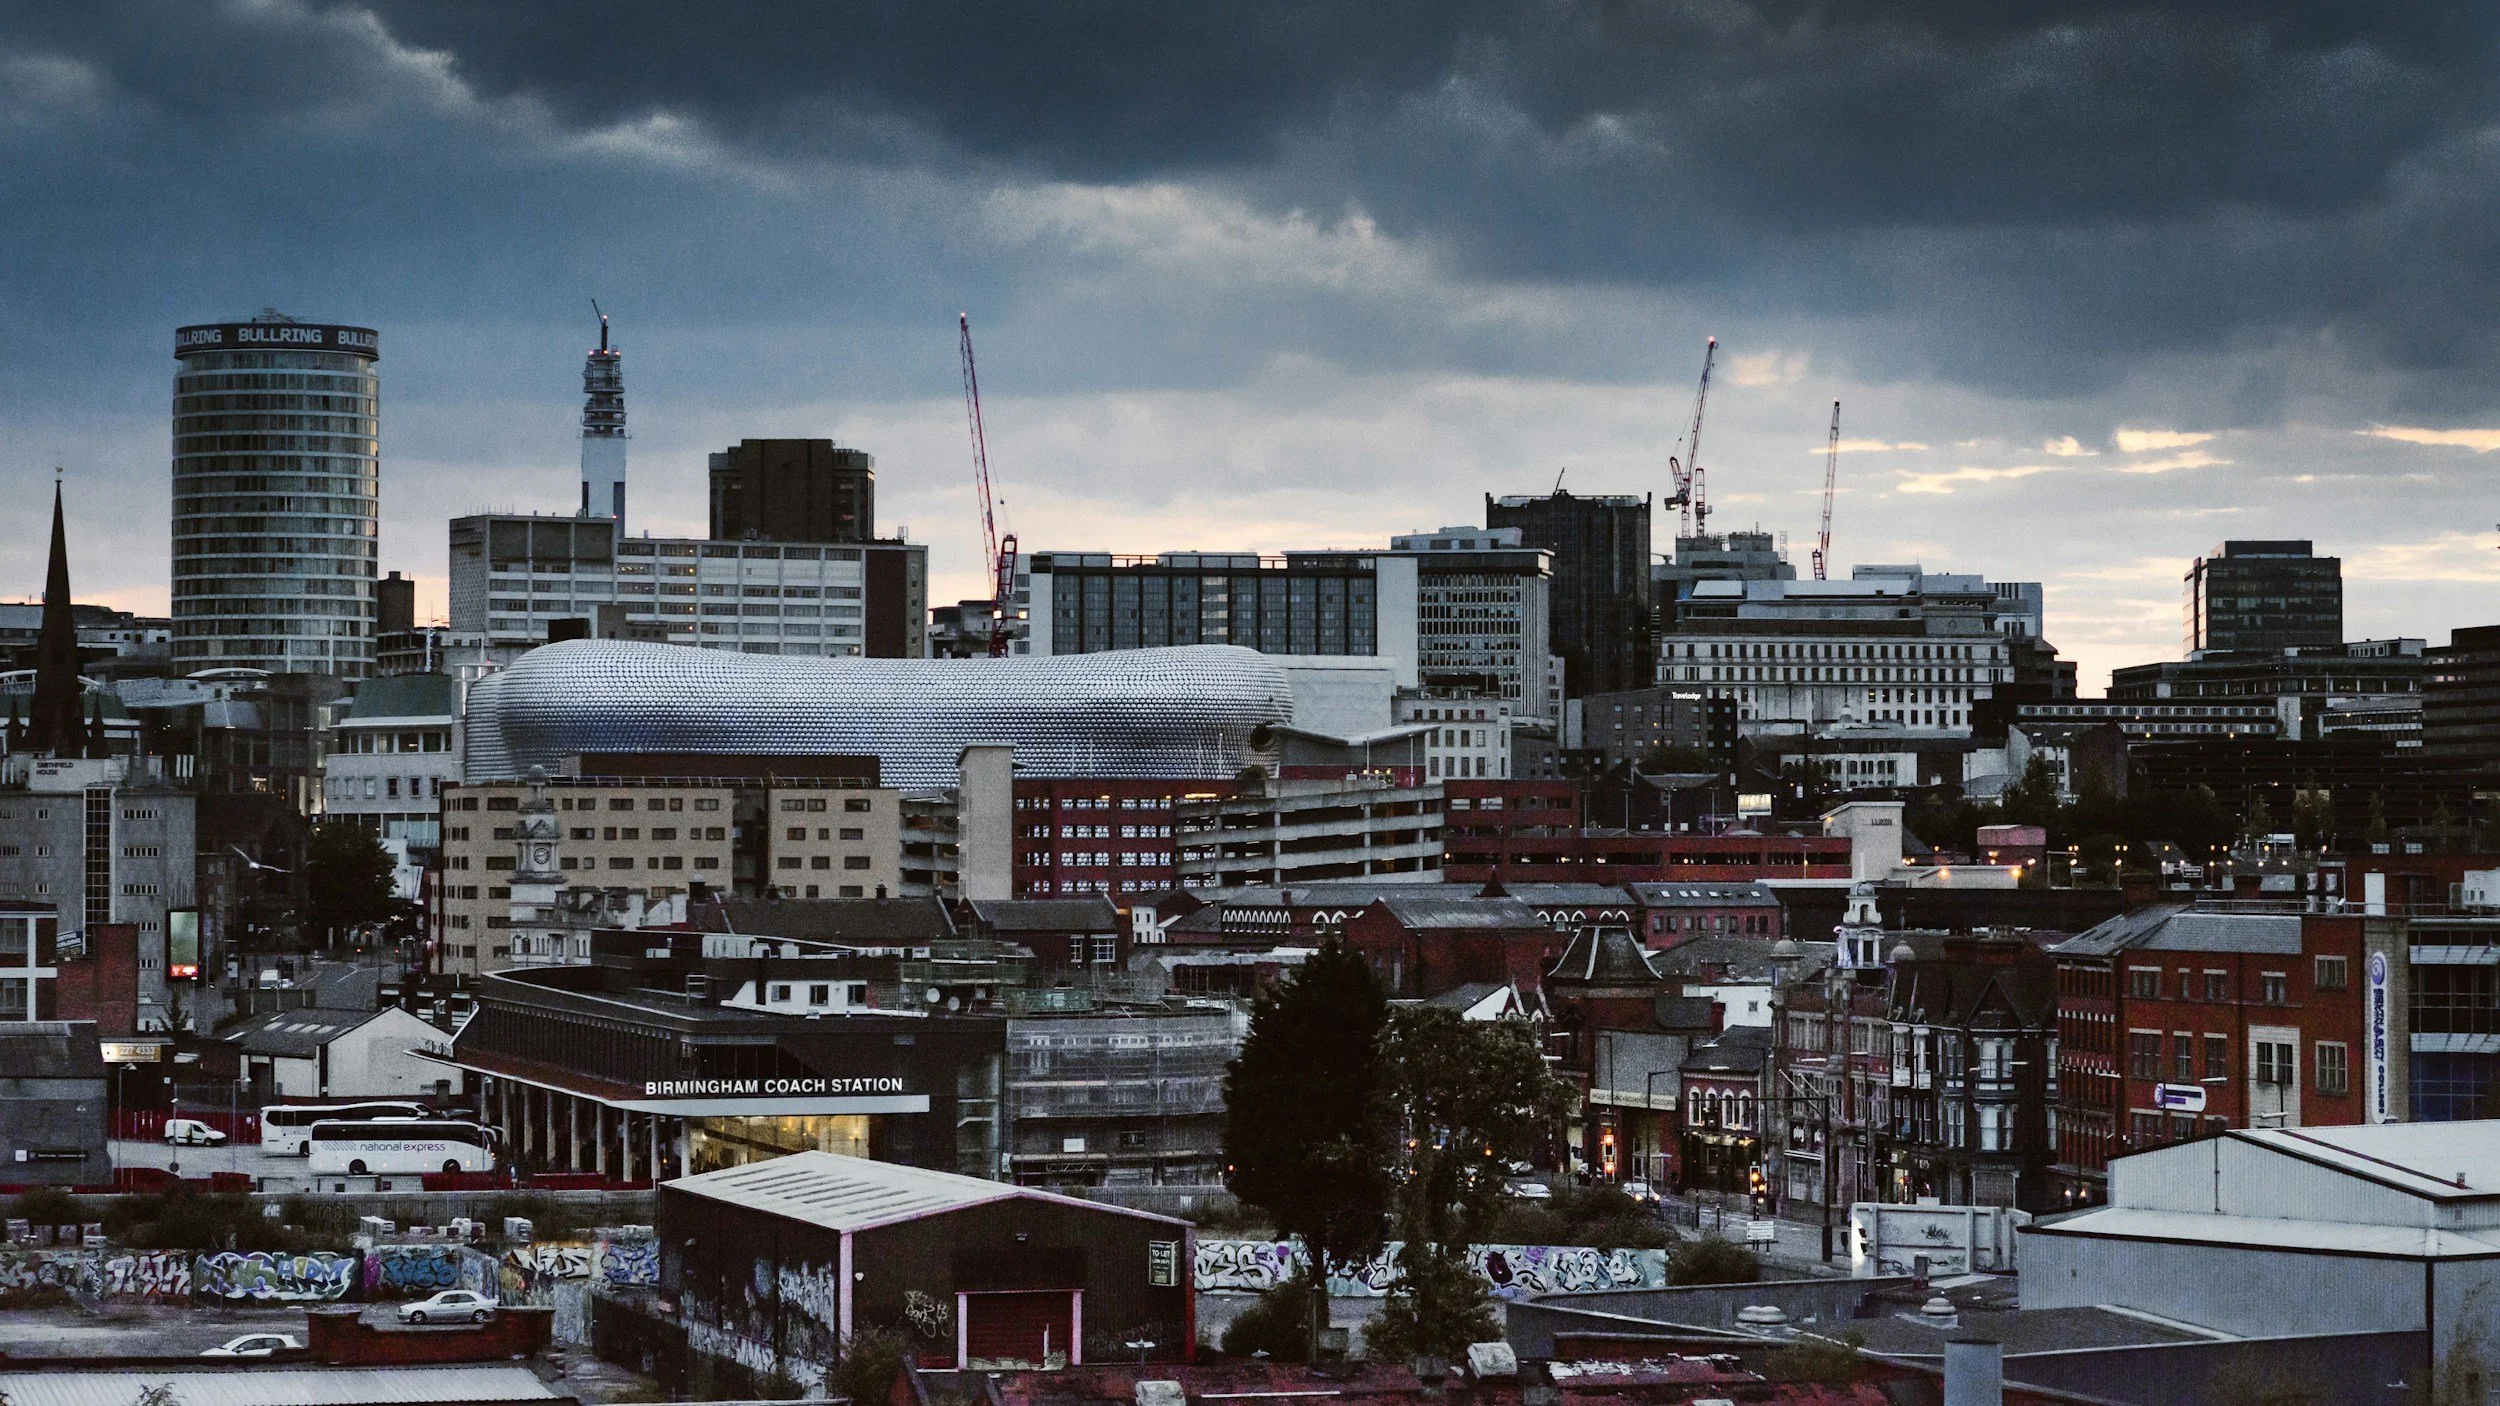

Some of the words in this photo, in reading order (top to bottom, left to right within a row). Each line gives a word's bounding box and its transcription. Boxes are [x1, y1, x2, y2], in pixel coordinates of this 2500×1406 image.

[238, 328, 323, 344] BULLRING
[1671, 691, 1701, 701] Travelodge
[645, 1079, 759, 1096] BIRMINGHAM
[764, 1078, 826, 1094] COACH
[831, 1077, 903, 1093] STATION
[360, 1141, 402, 1151] national
[403, 1143, 446, 1154] express
[1151, 1249, 1160, 1257] TO
[1160, 1250, 1171, 1258] LET
